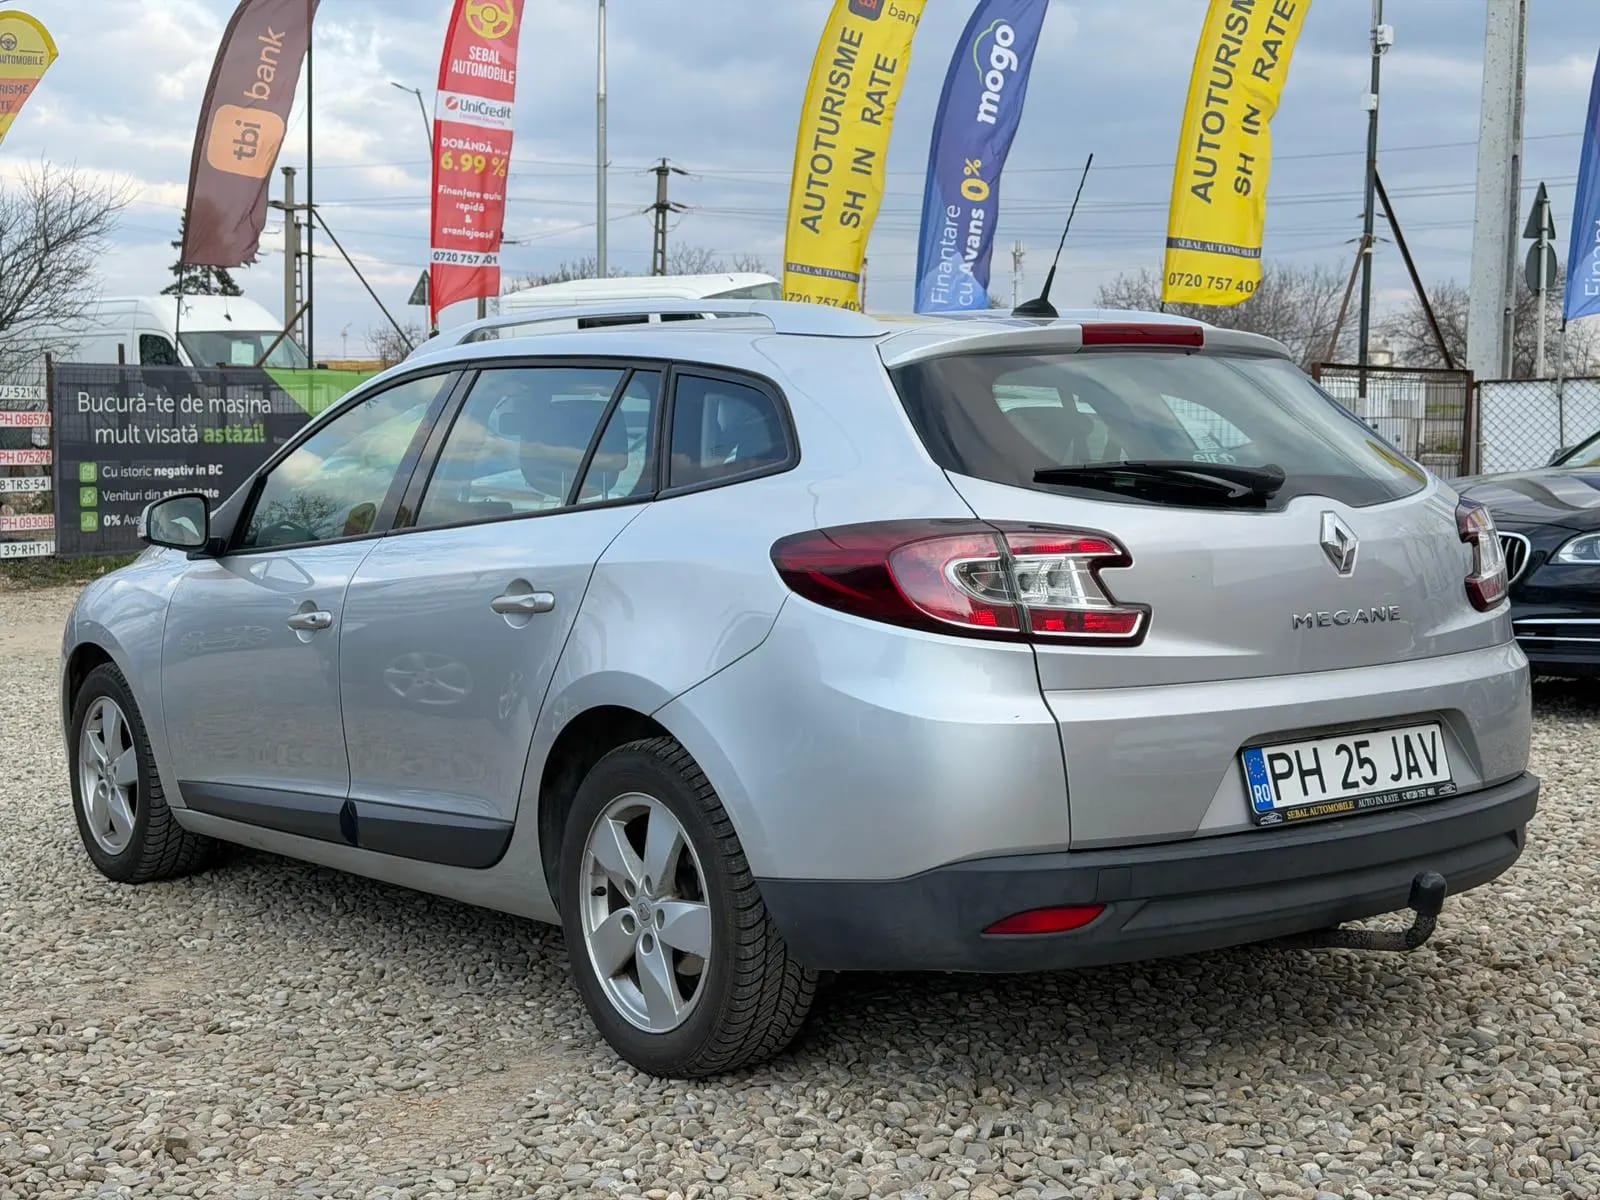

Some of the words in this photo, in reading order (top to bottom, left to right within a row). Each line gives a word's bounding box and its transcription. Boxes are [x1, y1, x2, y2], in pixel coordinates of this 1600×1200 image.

[243, 25, 286, 100] bank
[468, 46, 501, 65] SEBAL
[452, 58, 515, 85] AUTOMOBILE
[976, 24, 1018, 126] mogo
[861, 53, 898, 126] RATE
[460, 98, 512, 119] UniCredit
[1241, 103, 1262, 136] IN
[232, 119, 261, 160] tbi
[800, 26, 864, 234] AUTOTURISME
[441, 150, 487, 174] 6.99
[491, 156, 506, 177] %
[851, 147, 876, 176] IN
[1234, 152, 1255, 196] SH
[960, 158, 990, 202] 0%
[464, 214, 472, 224] &
[840, 190, 867, 229] SH
[930, 204, 961, 304] Finantare
[959, 208, 985, 276] Avans
[433, 252, 458, 262] 0720
[460, 254, 480, 264] 757
[958, 282, 974, 306] cu
[1168, 272, 1202, 288] 0720
[1208, 276, 1232, 291] 757
[78, 391, 175, 413] Bucură-te
[180, 393, 204, 413] de
[208, 394, 272, 418] mașina
[95, 424, 140, 444] mult
[144, 424, 198, 444] visată
[204, 424, 266, 443] astăzi!
[0, 452, 14, 463] PH
[102, 466, 118, 478] Cu
[120, 465, 152, 477] istoric
[154, 464, 194, 479] negativ
[208, 464, 223, 475] BC
[102, 490, 142, 501] Venituri
[144, 489, 160, 500] din
[2, 518, 17, 528] PH
[104, 514, 121, 526] 0%
[1292, 605, 1402, 630] MEGANE
[1267, 746, 1326, 800] PH
[1335, 740, 1378, 790] 25
[1390, 730, 1438, 782] JAV
[1254, 784, 1271, 803] RO
[1286, 808, 1310, 819] SEBAL
[1310, 800, 1354, 816] AUTOMOBILE
